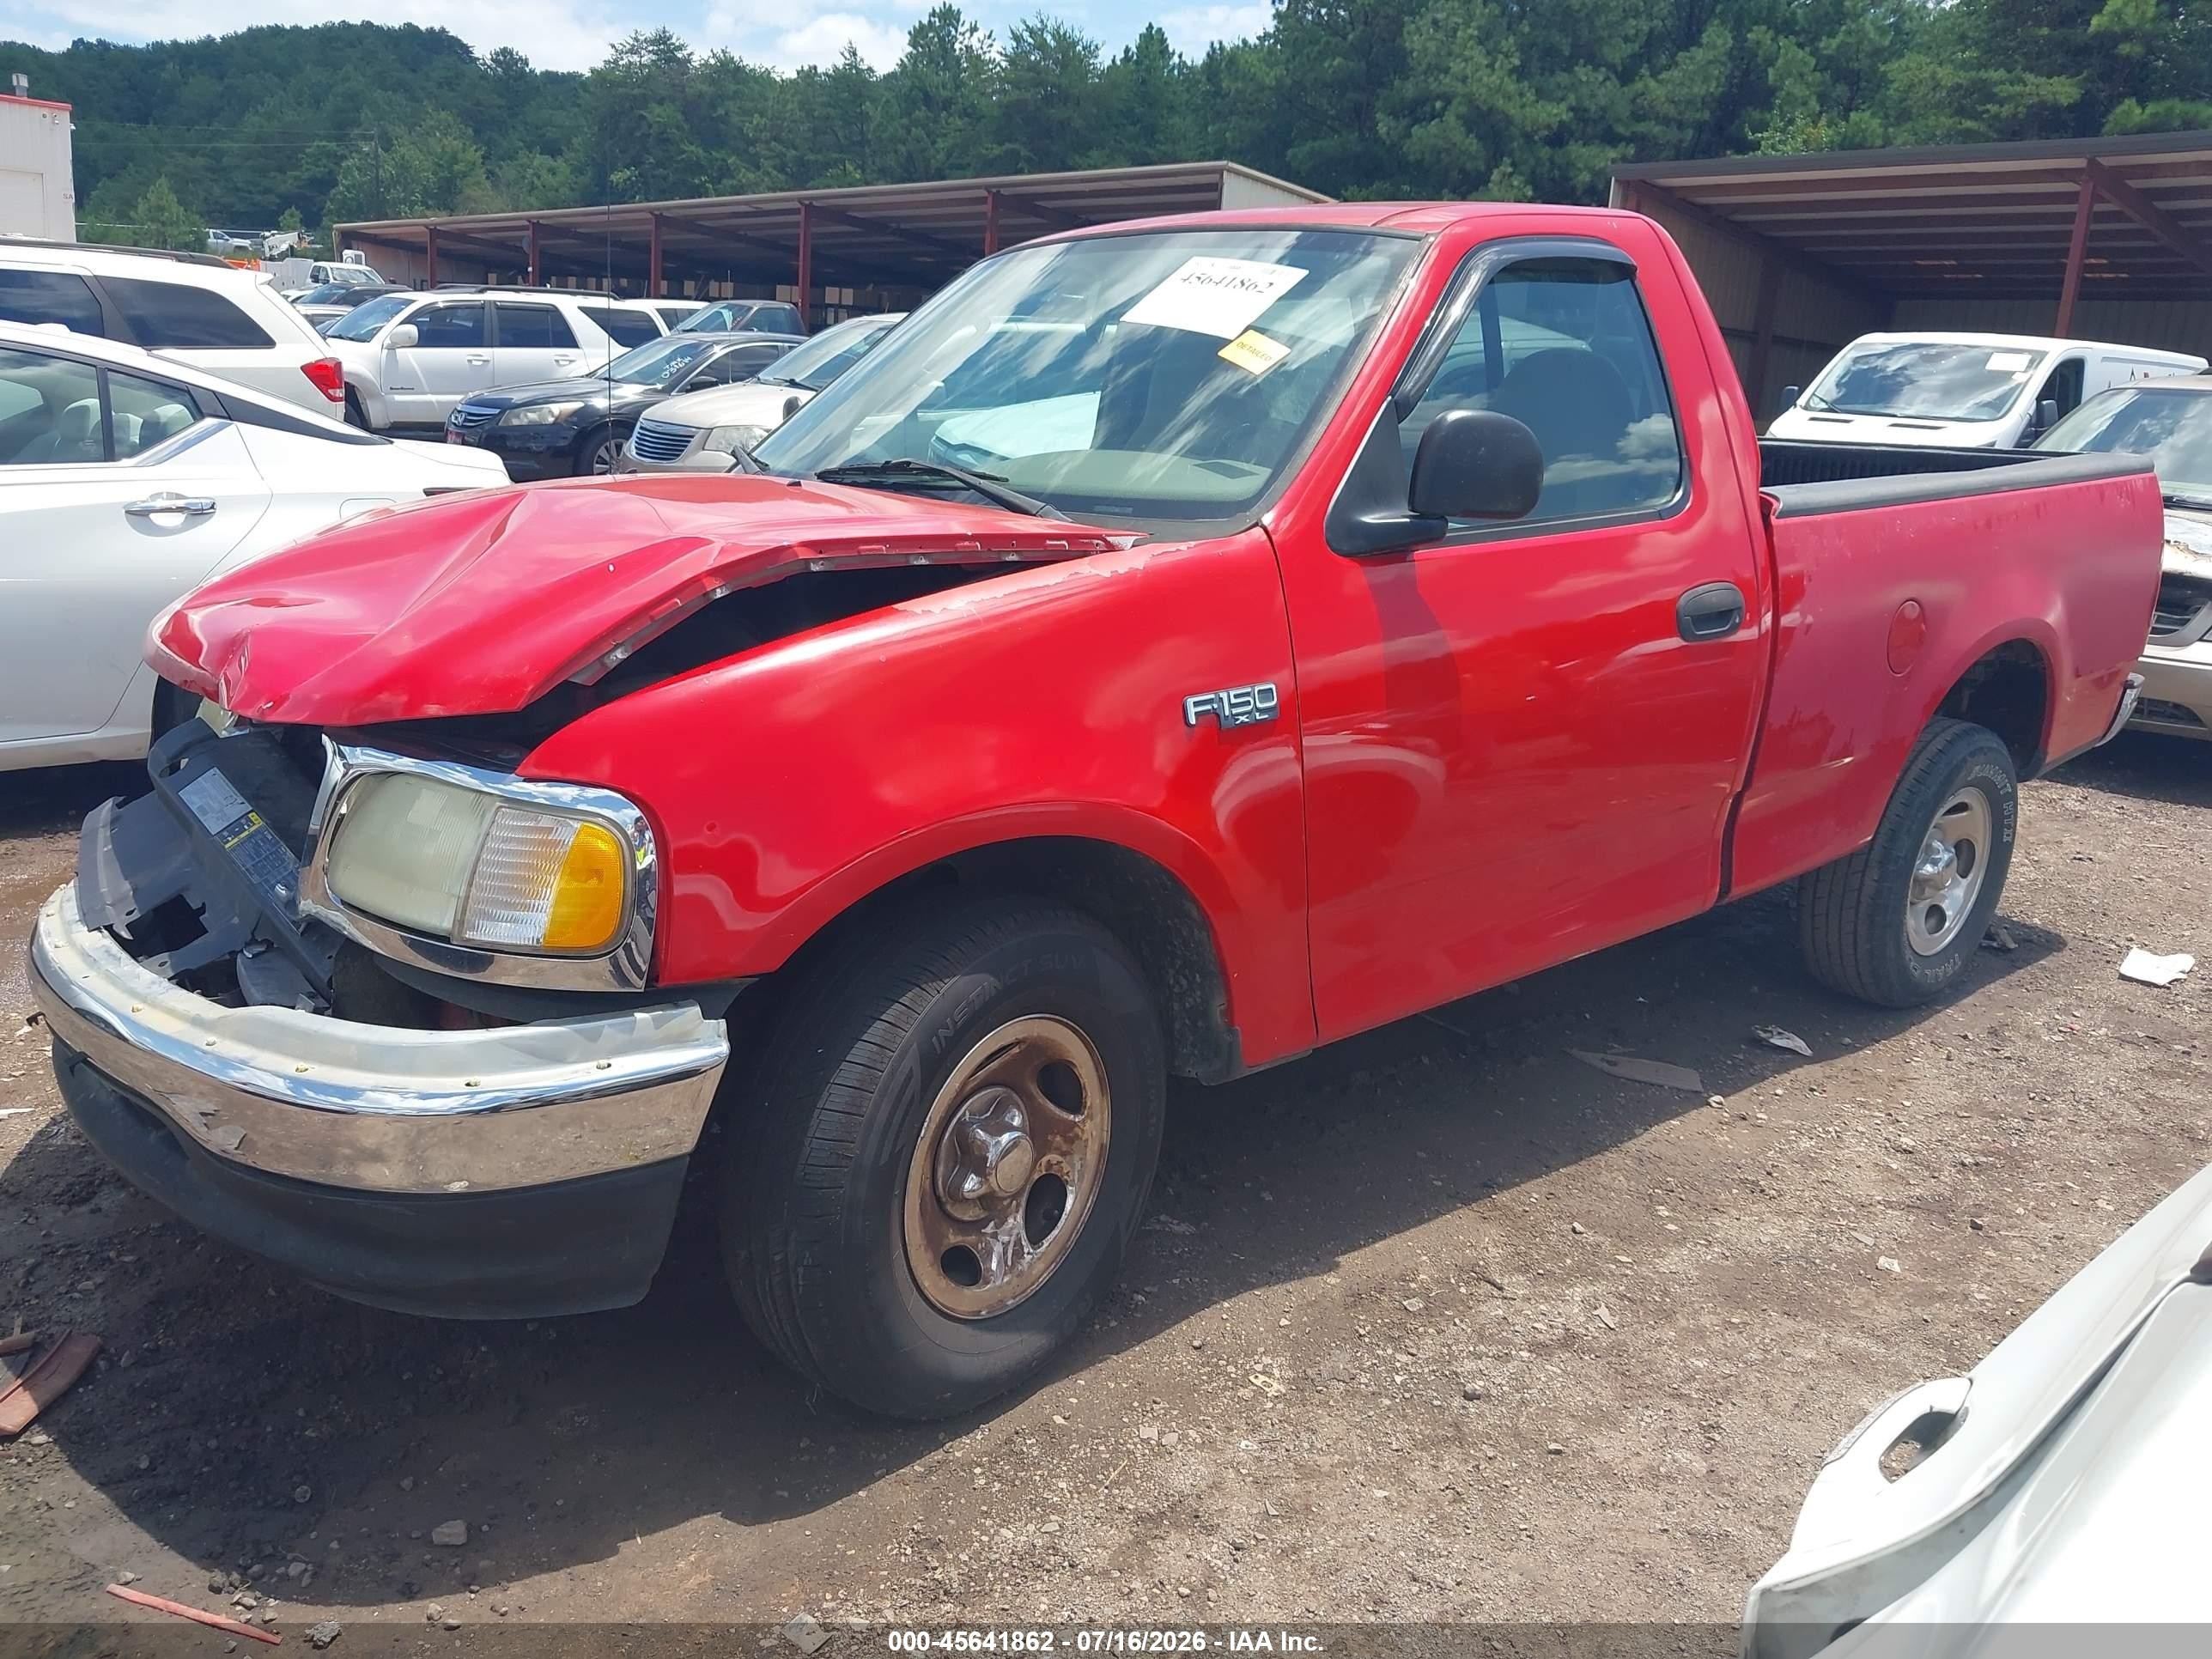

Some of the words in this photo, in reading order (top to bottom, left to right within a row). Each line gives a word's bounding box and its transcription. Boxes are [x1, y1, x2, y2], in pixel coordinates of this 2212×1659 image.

[1181, 271, 1274, 294] 45641862
[1234, 712, 1269, 725] XL
[932, 958, 1034, 1055] INSTINCT
